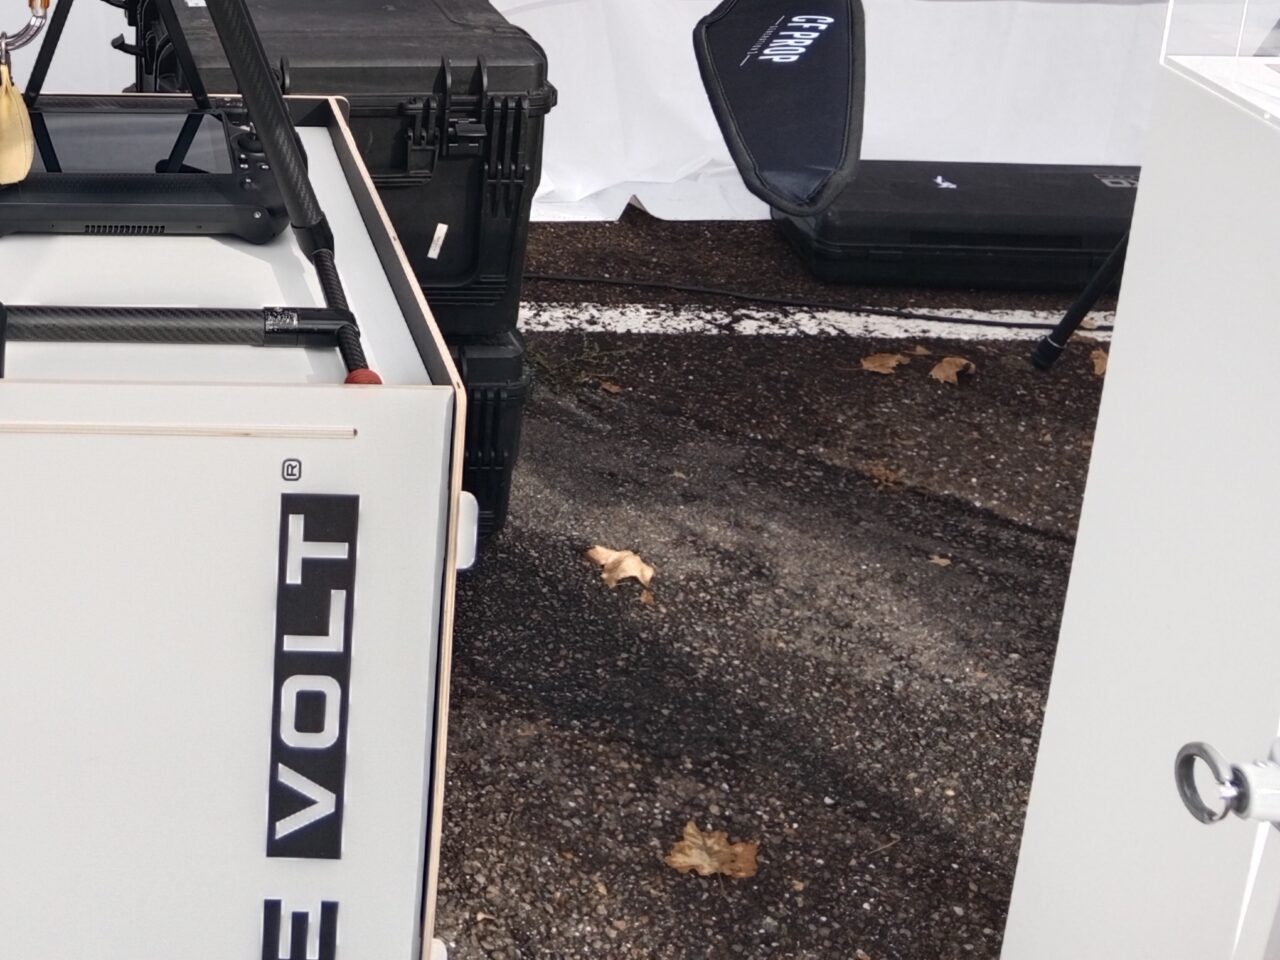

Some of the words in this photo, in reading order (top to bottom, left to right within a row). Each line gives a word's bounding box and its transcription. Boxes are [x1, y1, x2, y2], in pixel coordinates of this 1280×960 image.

[786, 15, 835, 30] CF
[758, 31, 820, 62] PROP
[274, 513, 349, 840] VOLT
